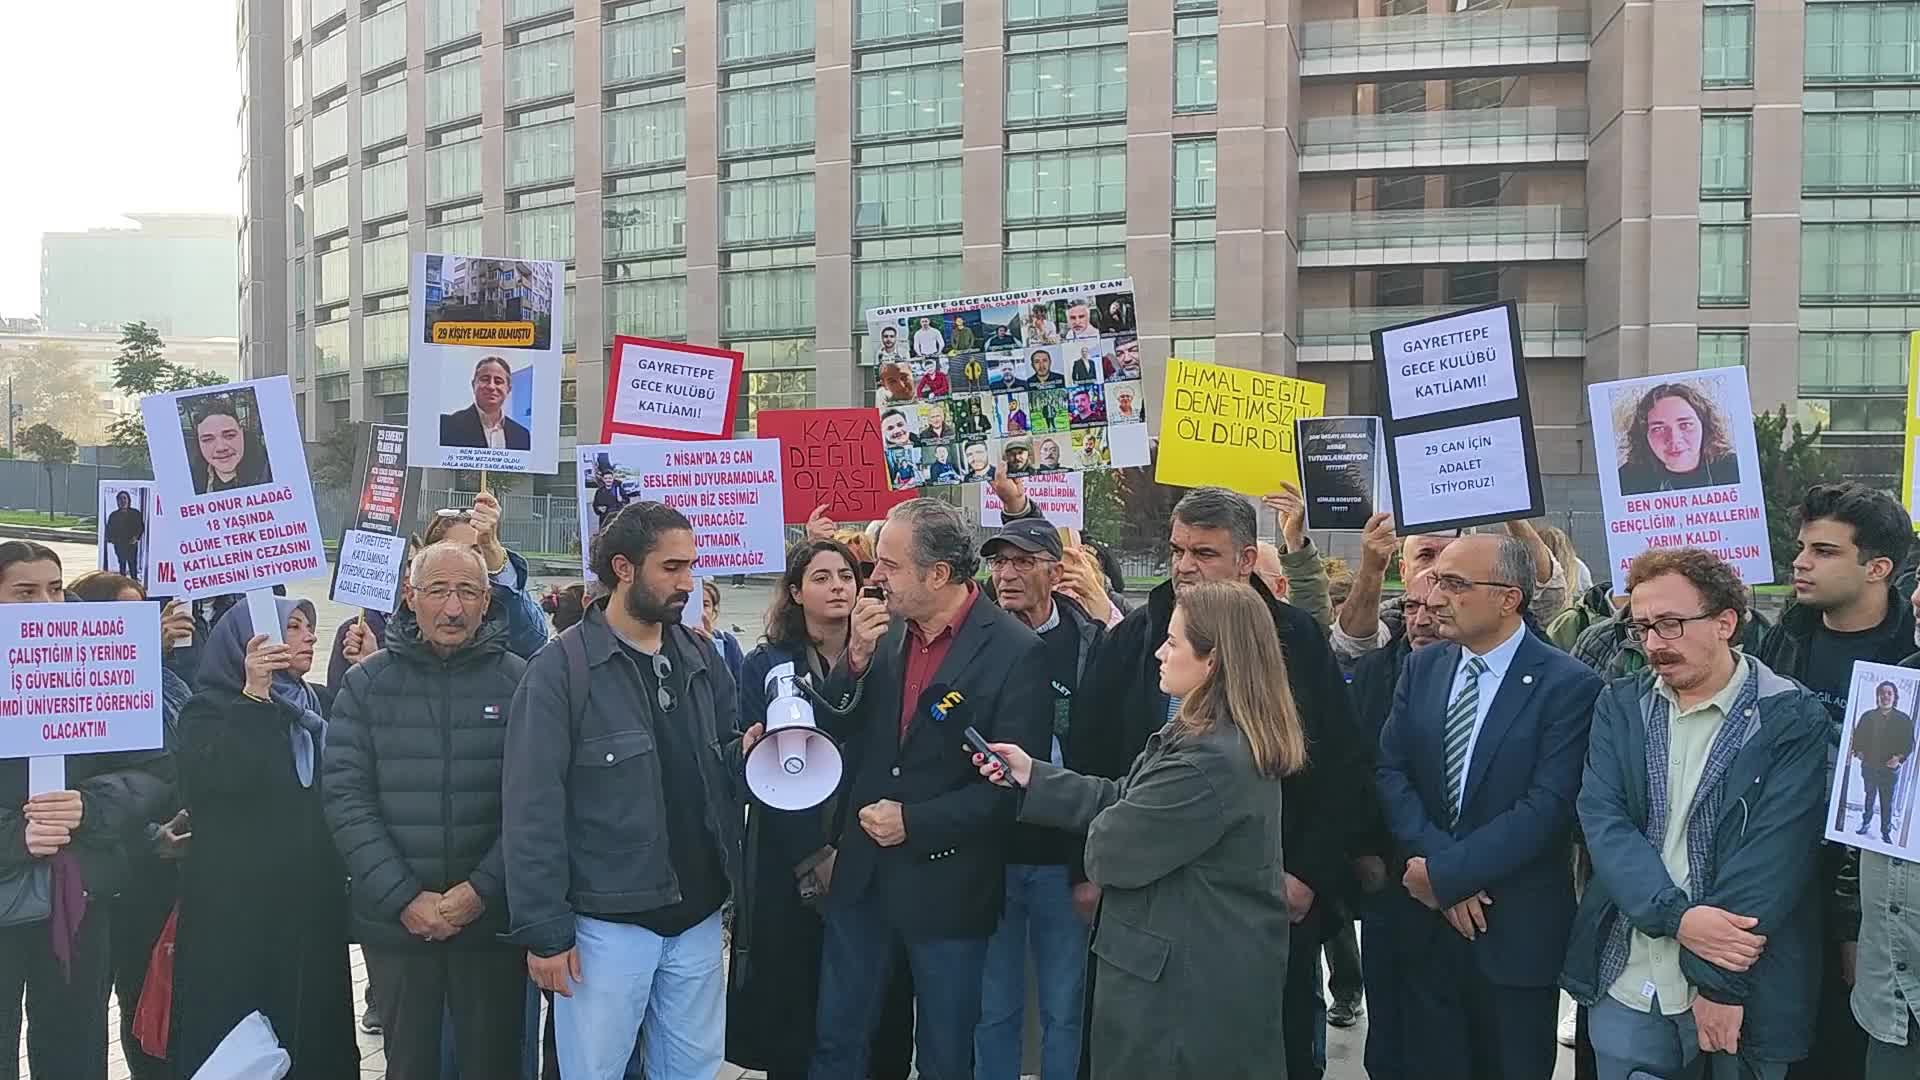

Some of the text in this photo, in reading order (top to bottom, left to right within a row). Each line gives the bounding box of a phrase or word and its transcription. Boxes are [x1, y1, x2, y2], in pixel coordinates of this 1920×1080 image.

[877, 303, 947, 315] GAYRETTEPE
[951, 298, 980, 307] GECE
[1083, 284, 1096, 292] 29
[1100, 281, 1123, 289] CAN
[1020, 297, 1041, 305] KAST
[438, 326, 531, 342] 29 KİŞİYE MEZAR OLMUŞTU
[1403, 326, 1489, 353] GAYRETTEPE
[638, 359, 715, 380] GAYRETTEPE
[1401, 347, 1497, 377] GECE KULÜBÜ
[631, 379, 715, 400] GECE KULÜBÜ
[1176, 361, 1311, 406] İHMAL DEĞİL
[1415, 374, 1487, 398] KATLİAMI!
[639, 400, 702, 418] KATLİAMI!
[803, 419, 881, 442] KAZA
[1177, 415, 1292, 454] ÖLDÜRDÜ
[1425, 435, 1492, 456] 29 CAN İÇİN
[666, 450, 752, 466] 2 NİSAN'DA 29 CAN
[1439, 458, 1482, 475] ADALET
[643, 470, 777, 488] SESLERİNİ DUYURAMADILAR.
[793, 470, 875, 490] OLASI
[1431, 475, 1495, 495] İSTİYORUZ!
[180, 503, 205, 518] BEN
[208, 497, 243, 513] ONUR
[246, 486, 293, 507] ALADAĞ
[700, 490, 716, 506] BİZ
[719, 488, 758, 505] SESİMİZİ
[815, 490, 881, 513] KAST
[1050, 502, 1079, 512] DUYUN,
[1627, 488, 1738, 513] BEN ONUR ALADAĞ
[206, 510, 274, 532] 18 YAŞINDA
[686, 510, 747, 527] YURACAĞIZ.
[1611, 513, 1675, 534] GENÇLİĞİM
[1686, 505, 1760, 525] HAYALLERİM
[179, 521, 308, 555] ÖLÜME TERK EDİLDİM
[355, 532, 393, 550] GAYRETTEPE
[695, 533, 740, 547] UTMADIK
[1646, 533, 1682, 548] YARIM
[1686, 530, 1721, 545] KALDI
[183, 540, 311, 572] KATİLLERİN CEZASINI
[183, 566, 250, 593] ÇEKMESİNİ
[253, 556, 318, 579] İSTİYORUM
[339, 580, 360, 593] ADALET
[21, 616, 124, 638] BEN ONUR ALADAĞ
[8, 641, 137, 669] ÇALIŞTIĞIM İŞ YERİNDE
[11, 667, 134, 694] İŞ GÜVENLİĞİ OLSAYDI
[0, 690, 154, 716] İMDİ ÜNİVERSİTE ÖĞRENCİSİ
[42, 720, 106, 740] OLACAKTIM
